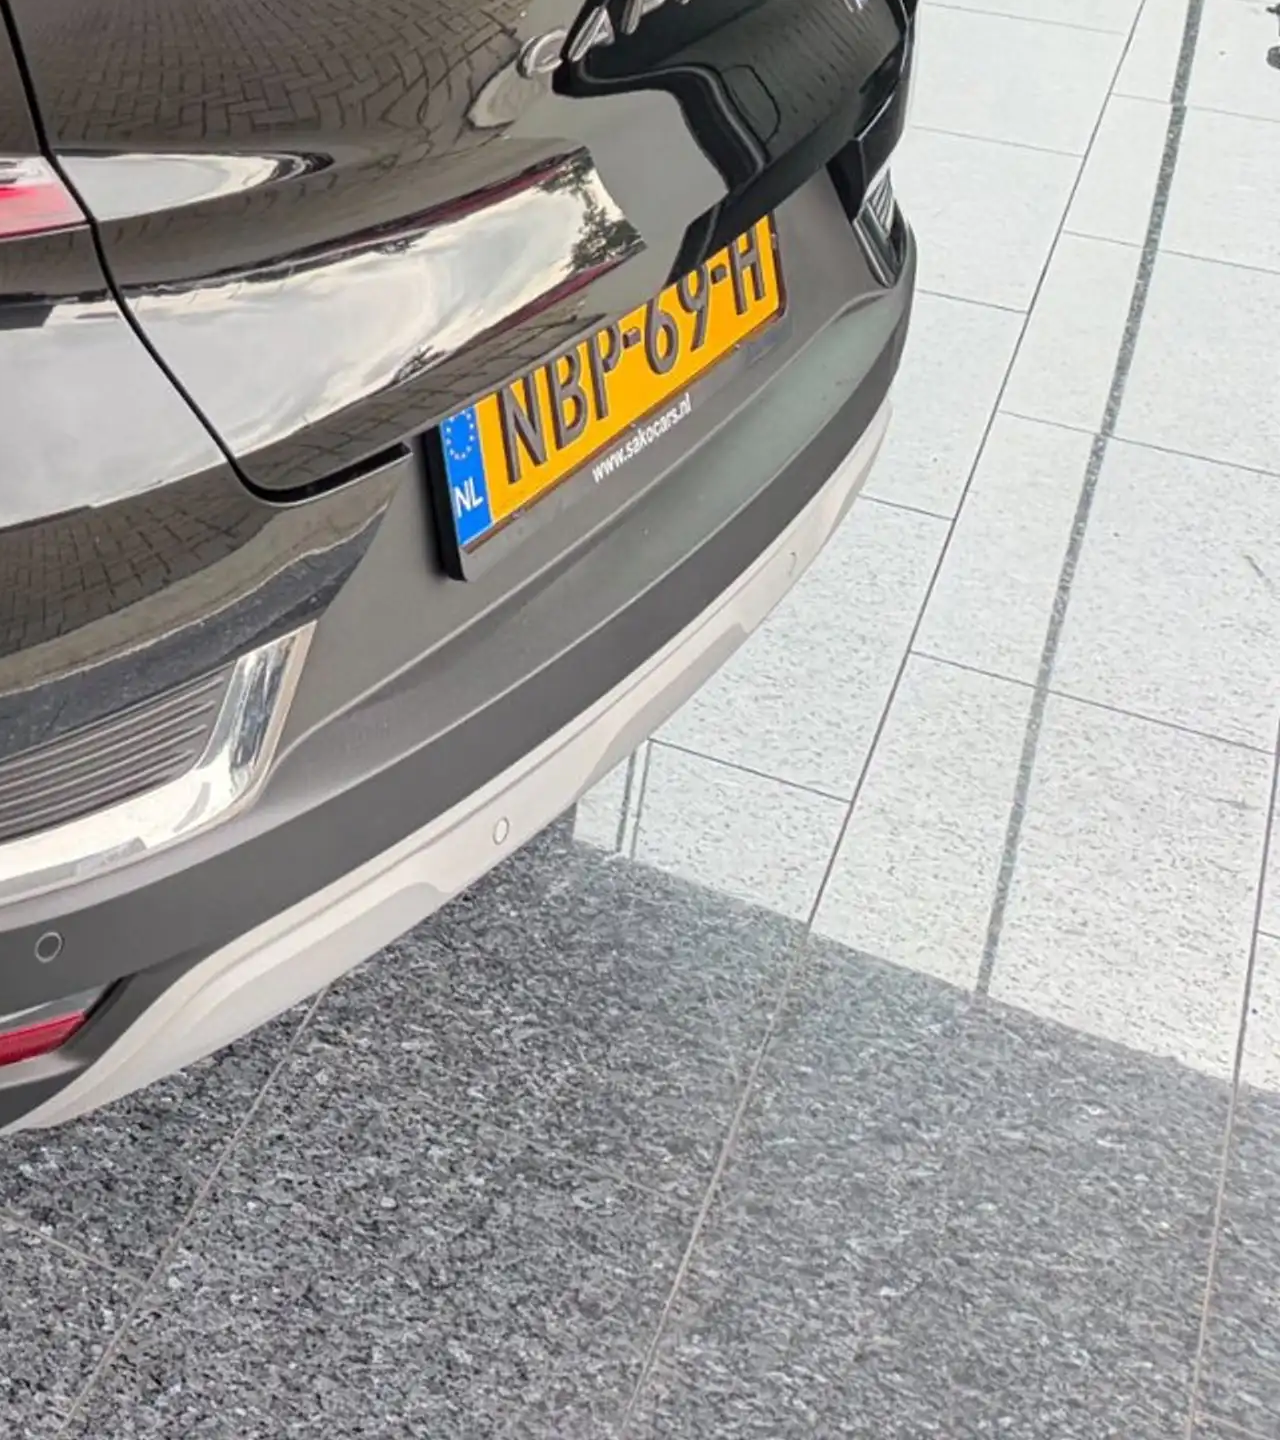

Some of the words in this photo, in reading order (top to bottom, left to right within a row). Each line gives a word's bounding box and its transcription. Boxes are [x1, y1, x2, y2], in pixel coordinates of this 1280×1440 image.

[496, 227, 766, 485] NBP-69-H
[590, 391, 694, 484] www.sakocars.nl
[454, 476, 484, 519] NL
